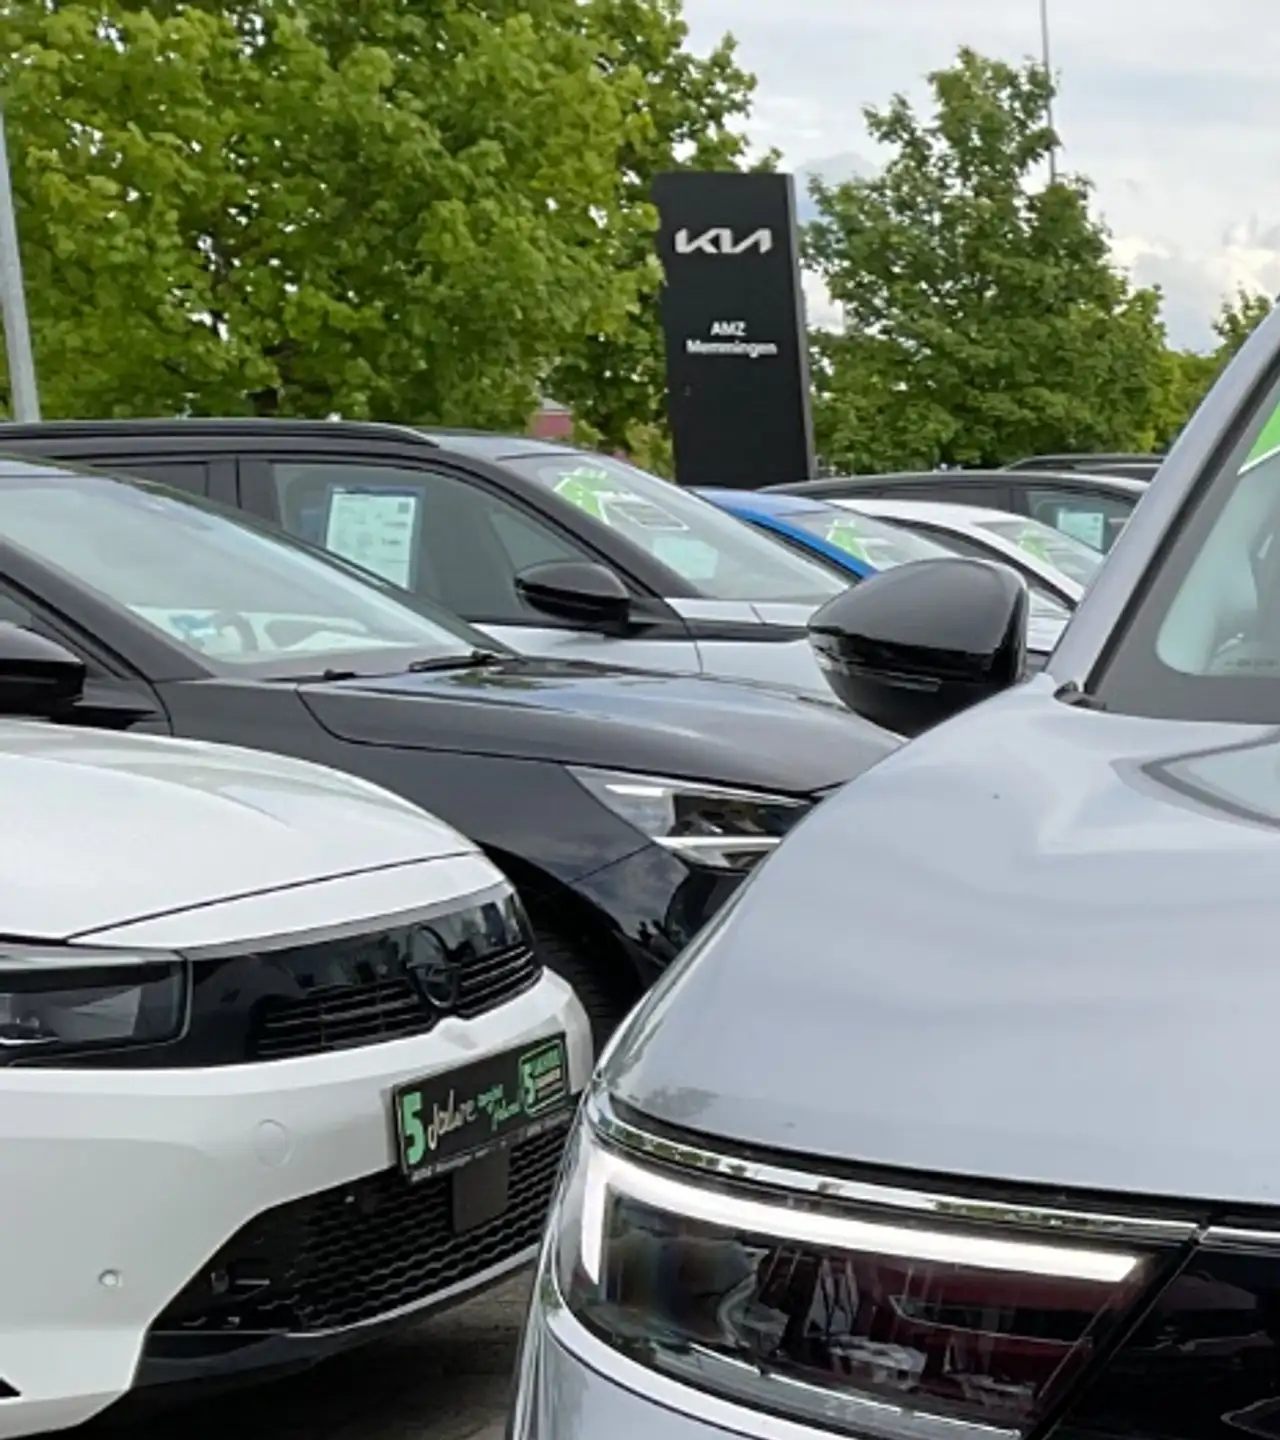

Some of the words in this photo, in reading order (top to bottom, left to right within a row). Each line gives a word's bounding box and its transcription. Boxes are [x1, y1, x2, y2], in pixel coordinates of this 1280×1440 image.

[674, 227, 773, 254] KIA
[710, 321, 747, 337] AMZ
[686, 339, 778, 358] Memmingen
[403, 1091, 425, 1165] 5
